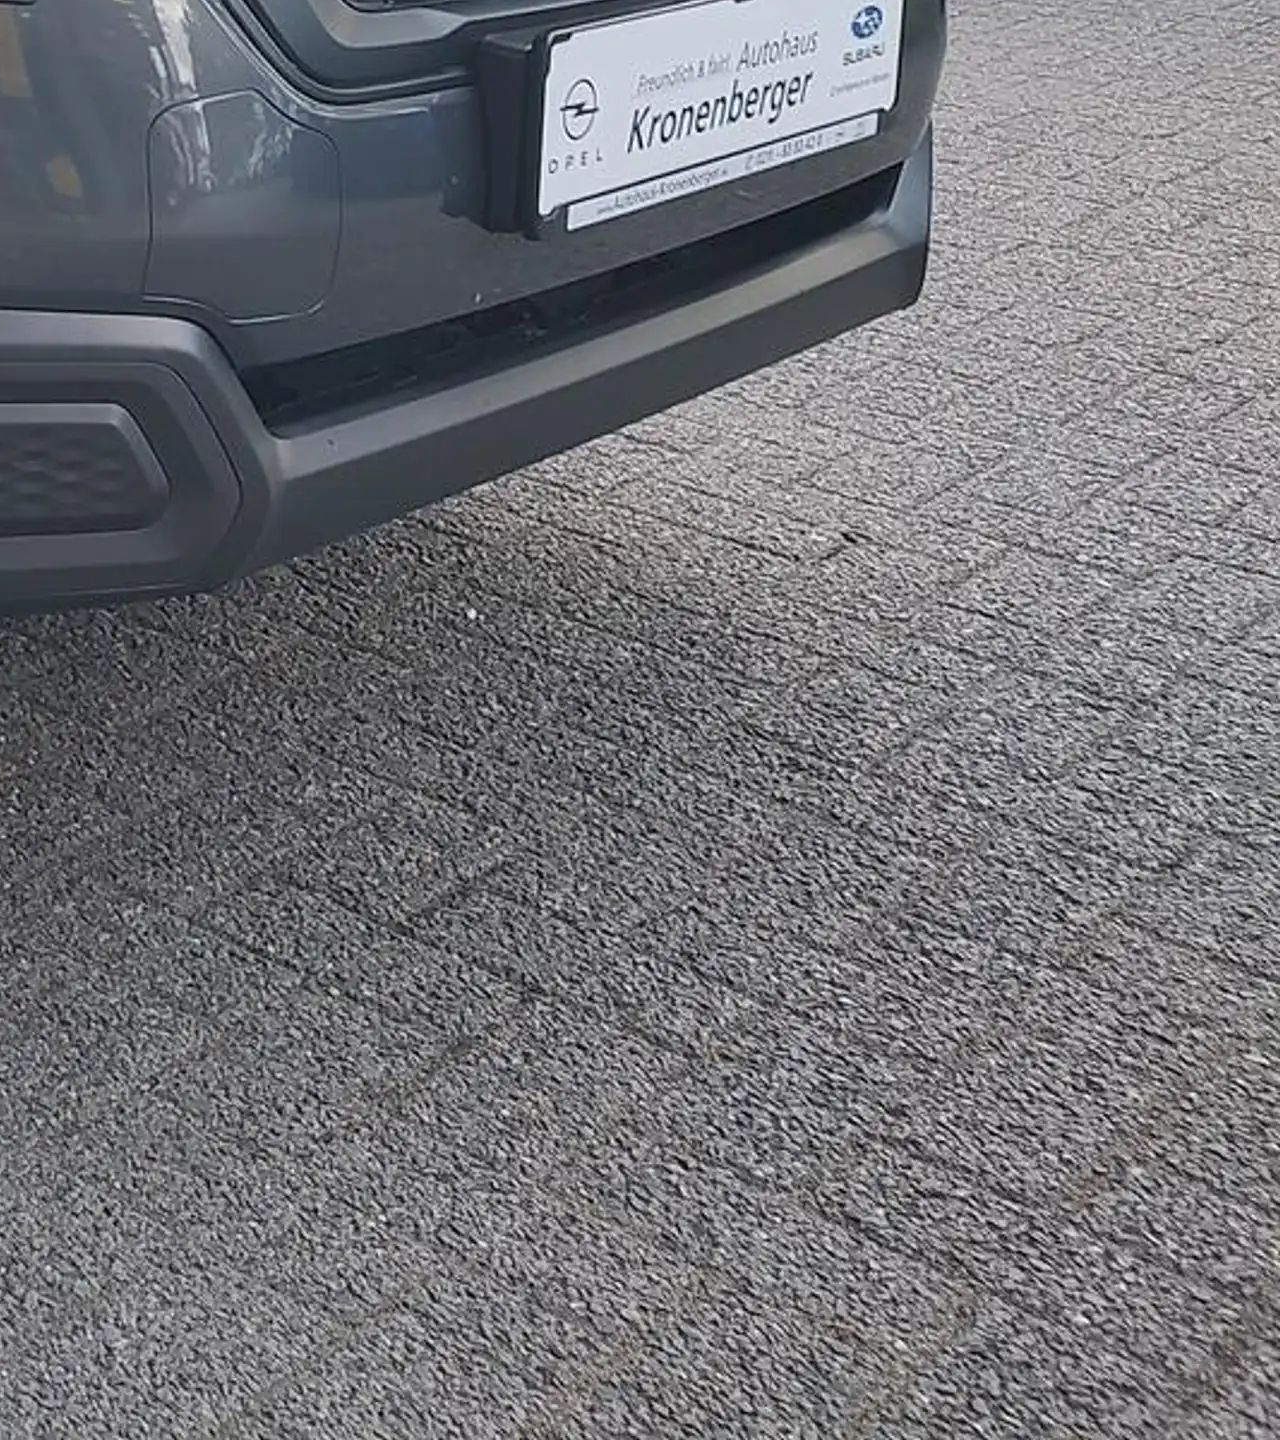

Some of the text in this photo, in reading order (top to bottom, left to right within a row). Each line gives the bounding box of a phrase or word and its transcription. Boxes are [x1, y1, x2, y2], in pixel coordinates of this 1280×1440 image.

[736, 30, 818, 71] Autohaus
[627, 71, 814, 154] Kronenberger
[548, 147, 603, 174] OPEL
